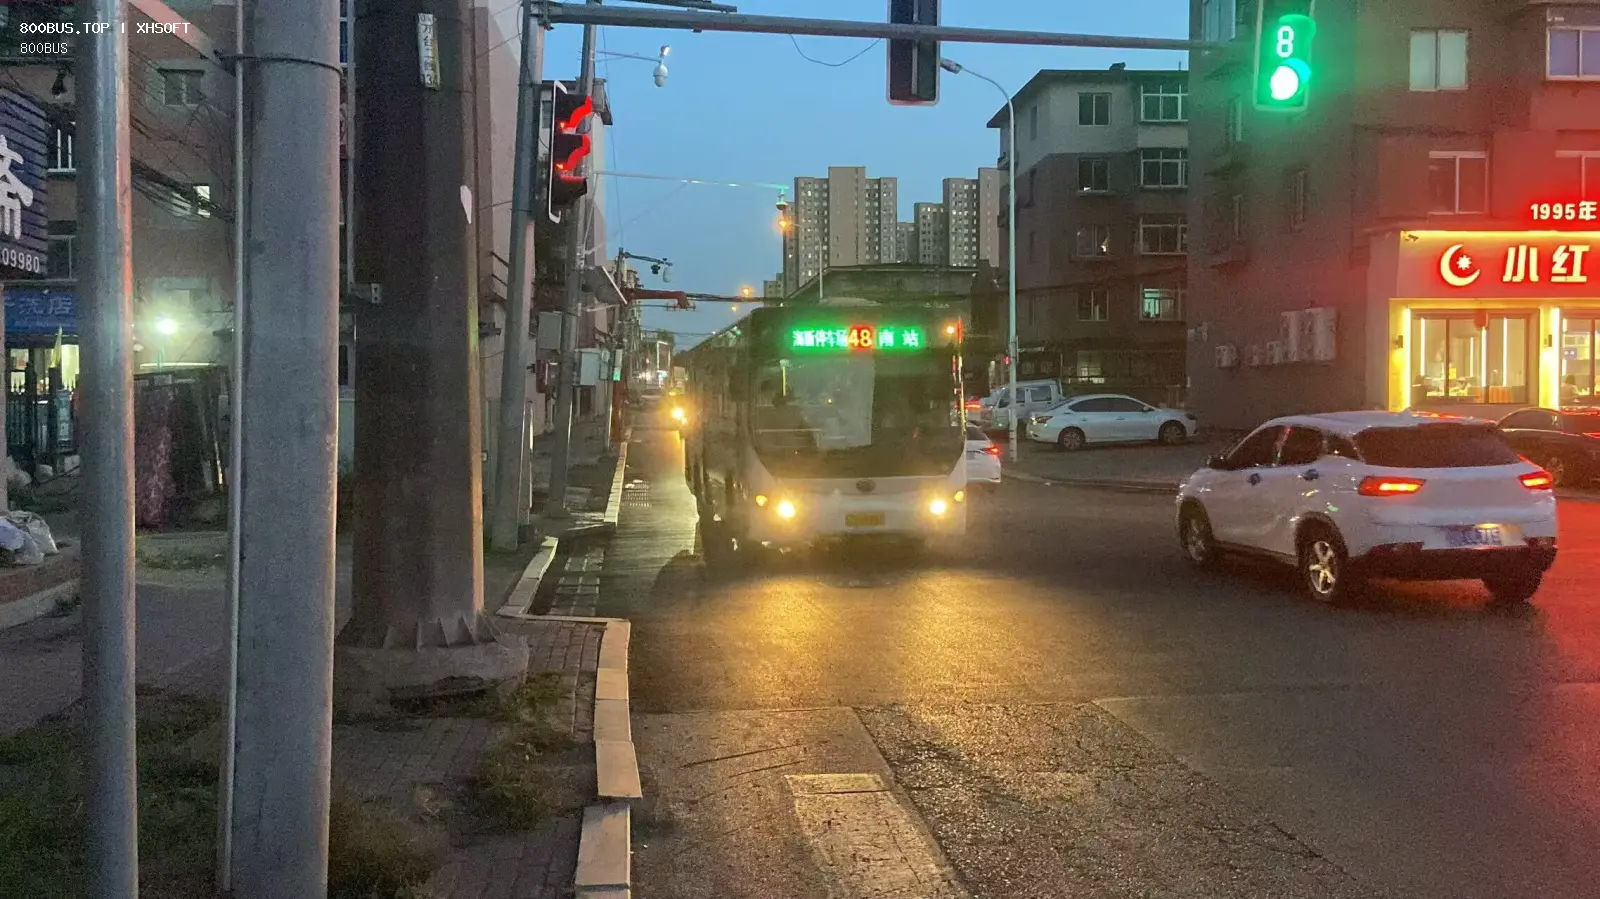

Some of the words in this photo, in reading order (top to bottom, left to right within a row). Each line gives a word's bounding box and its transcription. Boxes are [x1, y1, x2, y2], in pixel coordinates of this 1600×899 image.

[1276, 25, 1295, 58] 8
[1530, 200, 1597, 220] 1995年
[1502, 244, 1591, 283] 小红
[848, 328, 872, 347] 48
[879, 329, 919, 347] 南站
